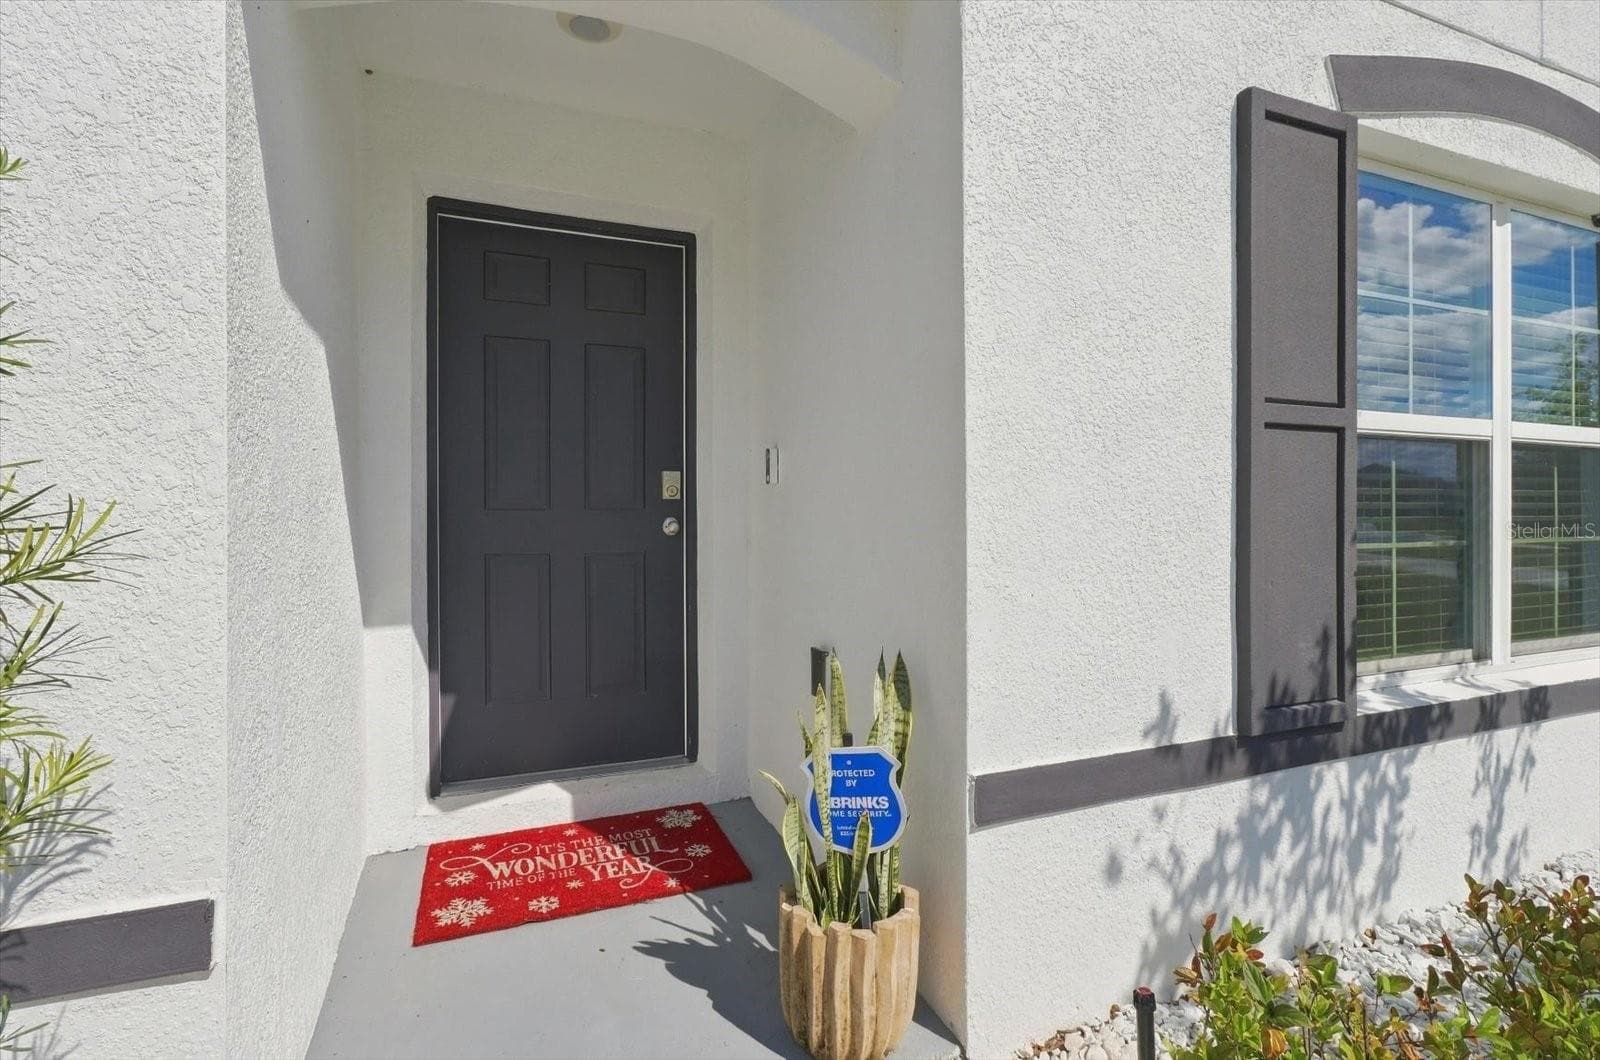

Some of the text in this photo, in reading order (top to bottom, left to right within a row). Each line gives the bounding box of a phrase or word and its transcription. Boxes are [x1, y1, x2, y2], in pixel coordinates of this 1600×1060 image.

[831, 769, 875, 777] ROTECTED
[845, 779, 857, 787] BY
[831, 796, 890, 809] BRINKS
[535, 828, 652, 855] IT'S THE MOST
[482, 836, 679, 880] WONDERFUL
[486, 855, 656, 891] TIME OF THE YEAR
